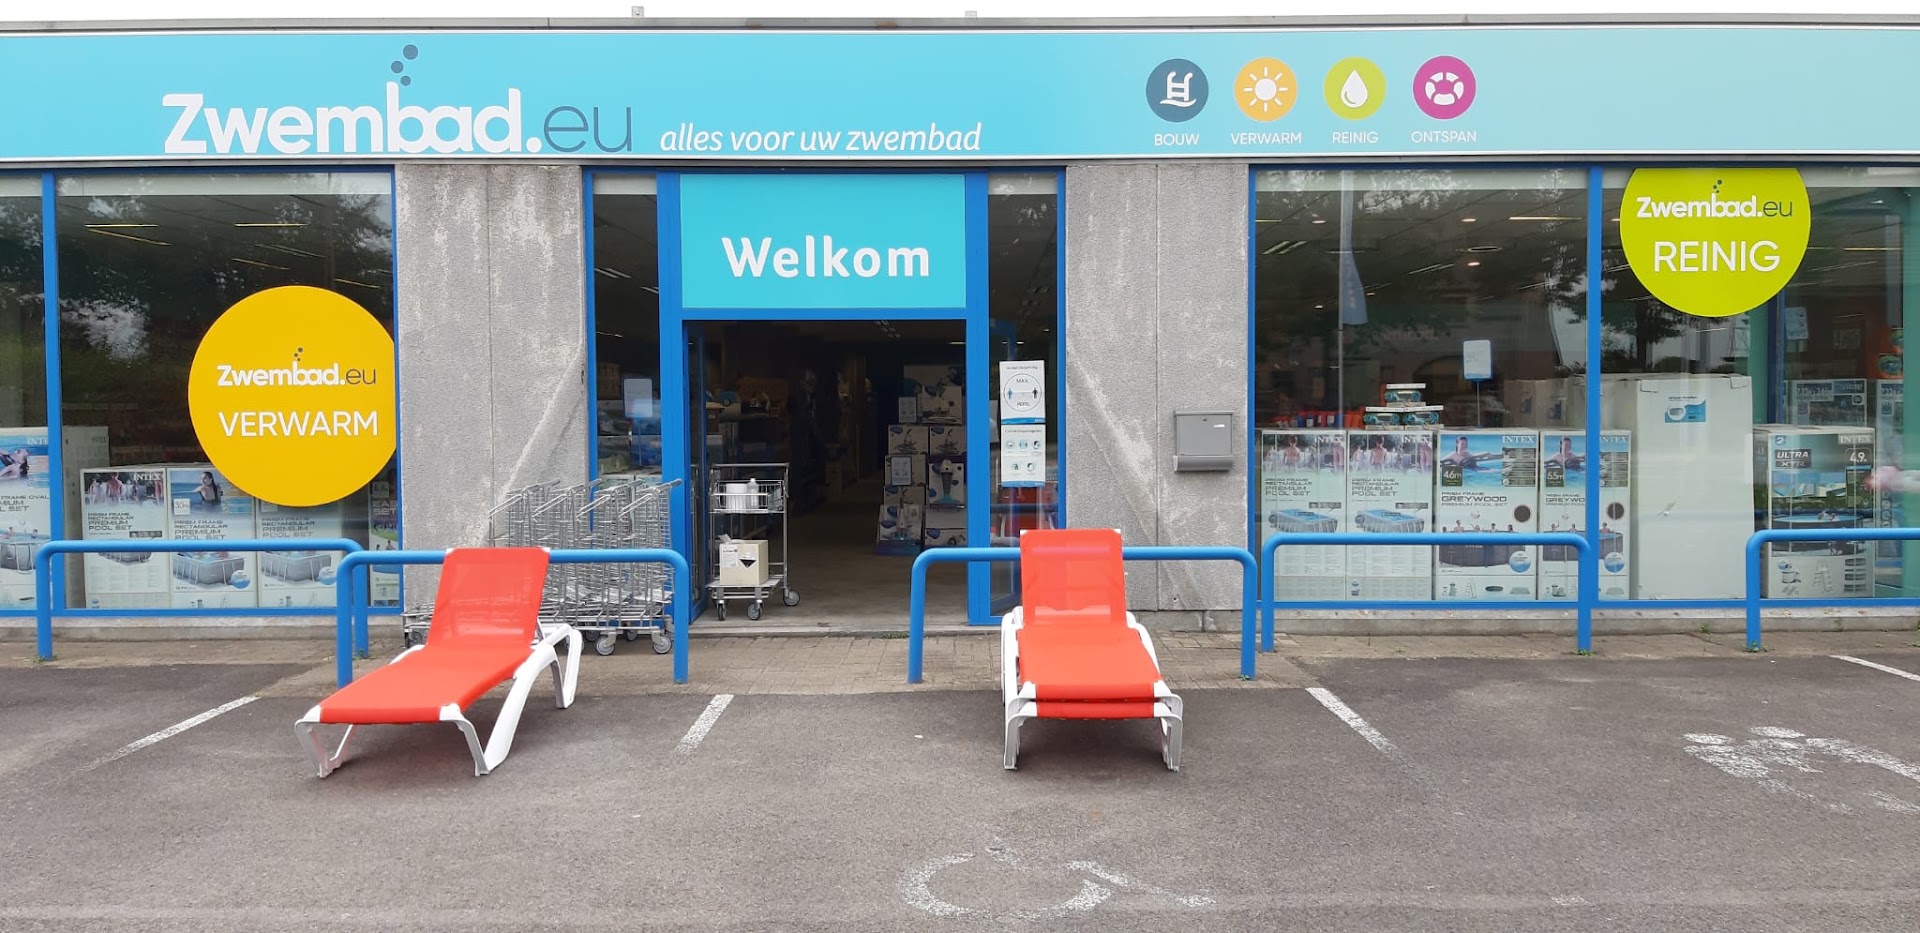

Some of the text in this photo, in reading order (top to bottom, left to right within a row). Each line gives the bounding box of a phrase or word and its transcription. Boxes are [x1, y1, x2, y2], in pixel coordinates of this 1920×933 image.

[162, 81, 632, 154] Zwembad.eu
[660, 122, 982, 151] alles voor uw zwembad
[1154, 133, 1200, 146] BOUW
[1230, 132, 1303, 145] VERWARM
[1332, 131, 1379, 144] REINIG
[1411, 130, 1477, 143] ONTSPAN
[1636, 192, 1793, 218] Zwembad.eu
[721, 235, 930, 278] Welkom
[1654, 240, 1781, 272] REINIG
[216, 360, 377, 387] Zwembad.eu
[218, 410, 379, 437] VERWARM
[1840, 435, 1871, 443] INTEX
[1777, 451, 1809, 459] ULTRA
